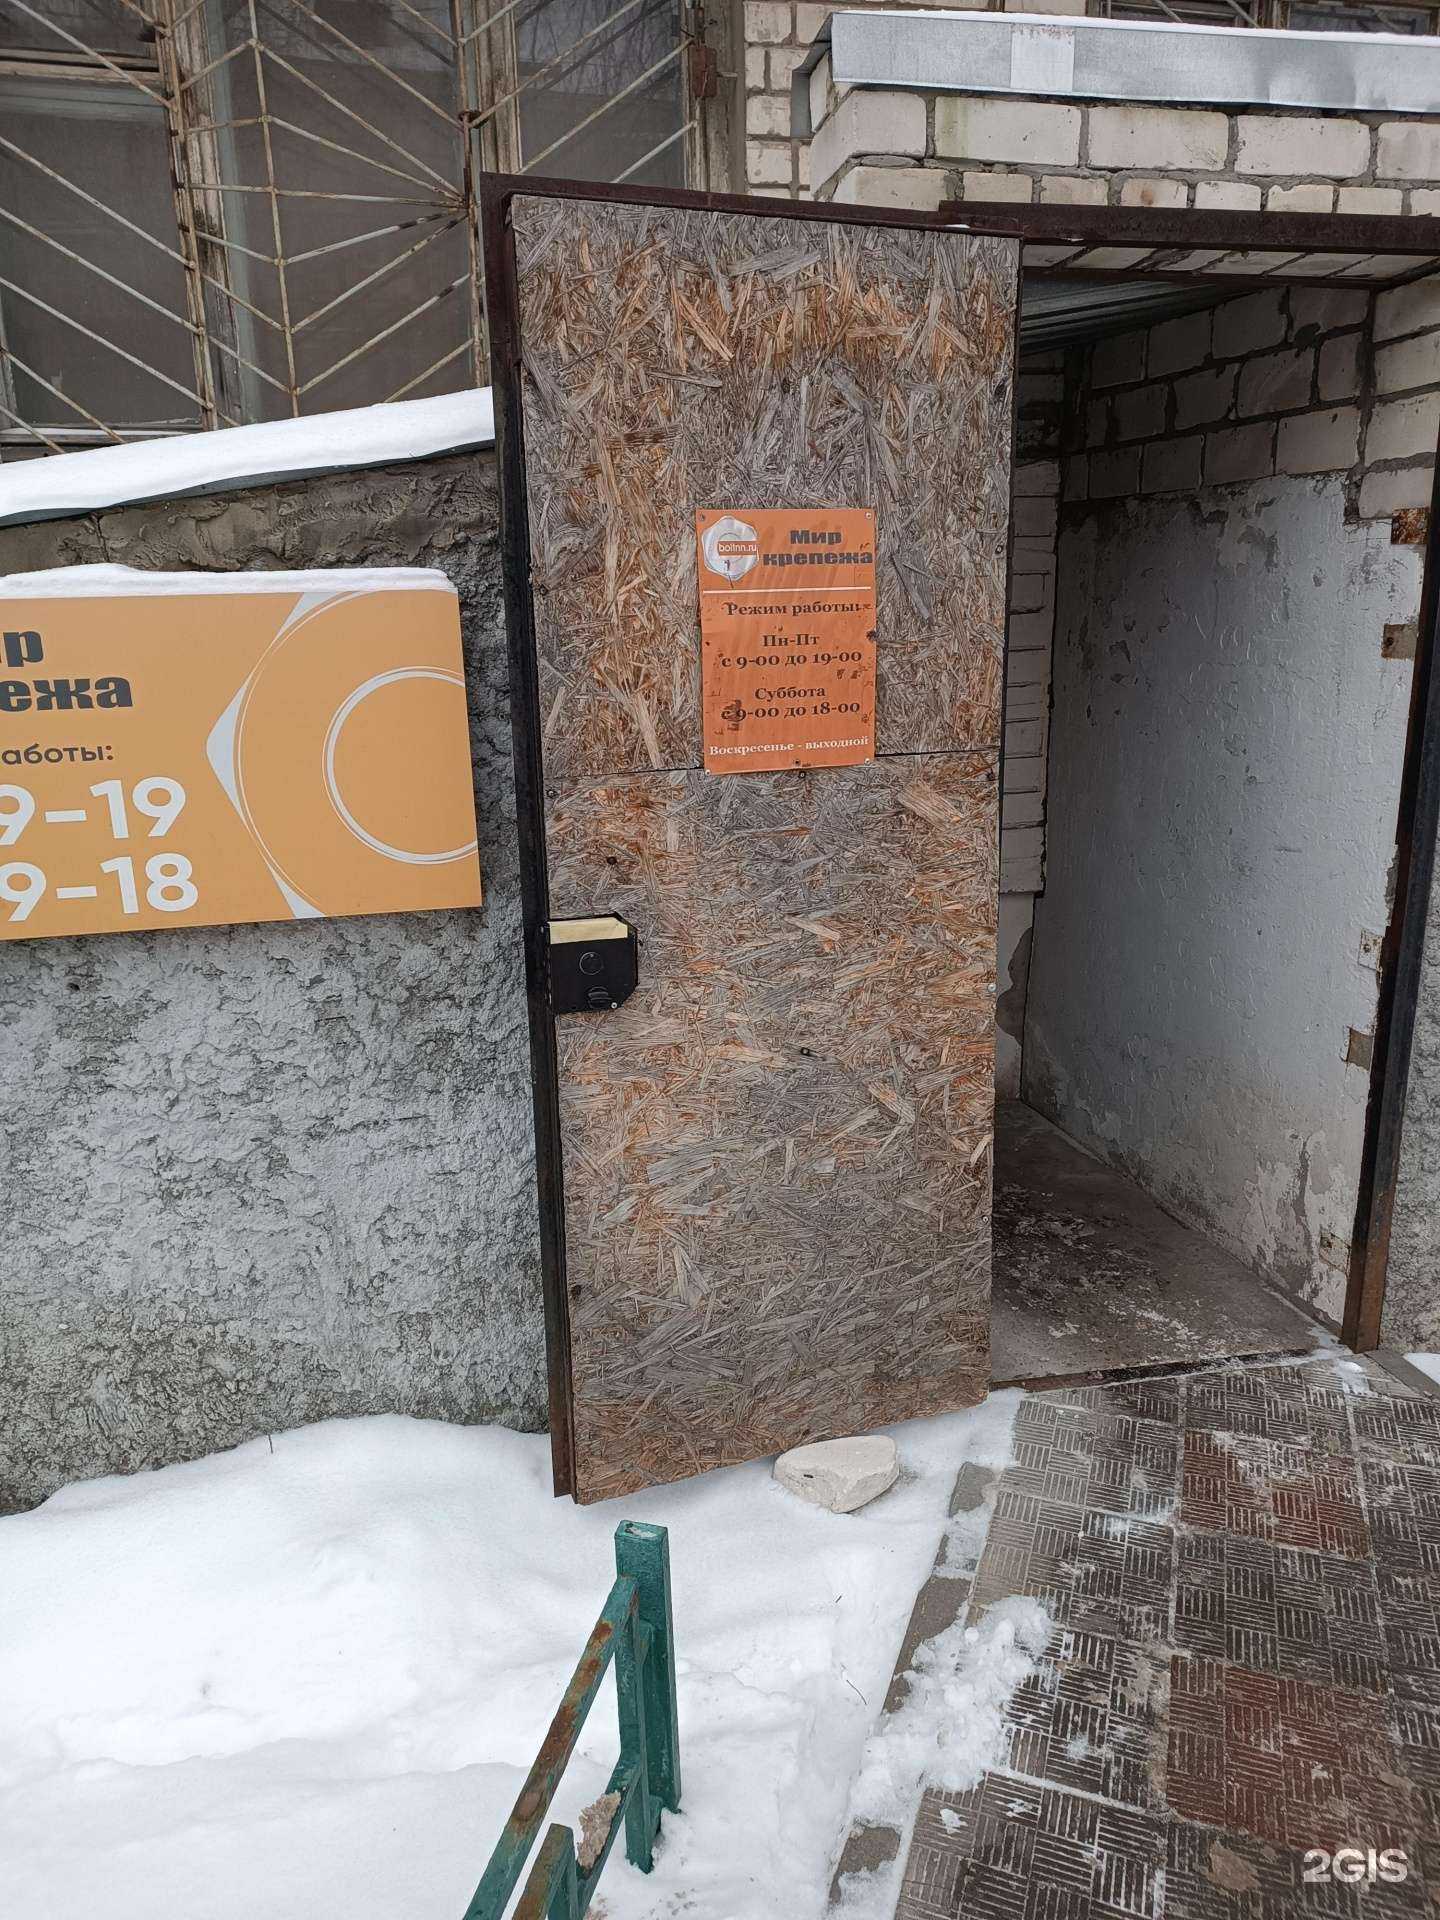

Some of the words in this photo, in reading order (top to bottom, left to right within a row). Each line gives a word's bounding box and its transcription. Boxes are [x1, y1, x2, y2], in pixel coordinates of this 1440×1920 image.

[790, 530, 842, 545] Мир
[763, 550, 873, 566] крепежа
[726, 602, 787, 615] Режим
[792, 601, 859, 616] работы:
[763, 634, 820, 647] Пн-Пт
[721, 657, 731, 667] с
[736, 655, 780, 669] 9-00
[785, 654, 807, 667] до
[813, 651, 862, 665] 19-00
[755, 686, 826, 701] Суббота
[784, 706, 806, 718] до
[811, 701, 860, 716] 18-00
[710, 742, 794, 756] Воскресенье
[805, 735, 869, 750] выходной
